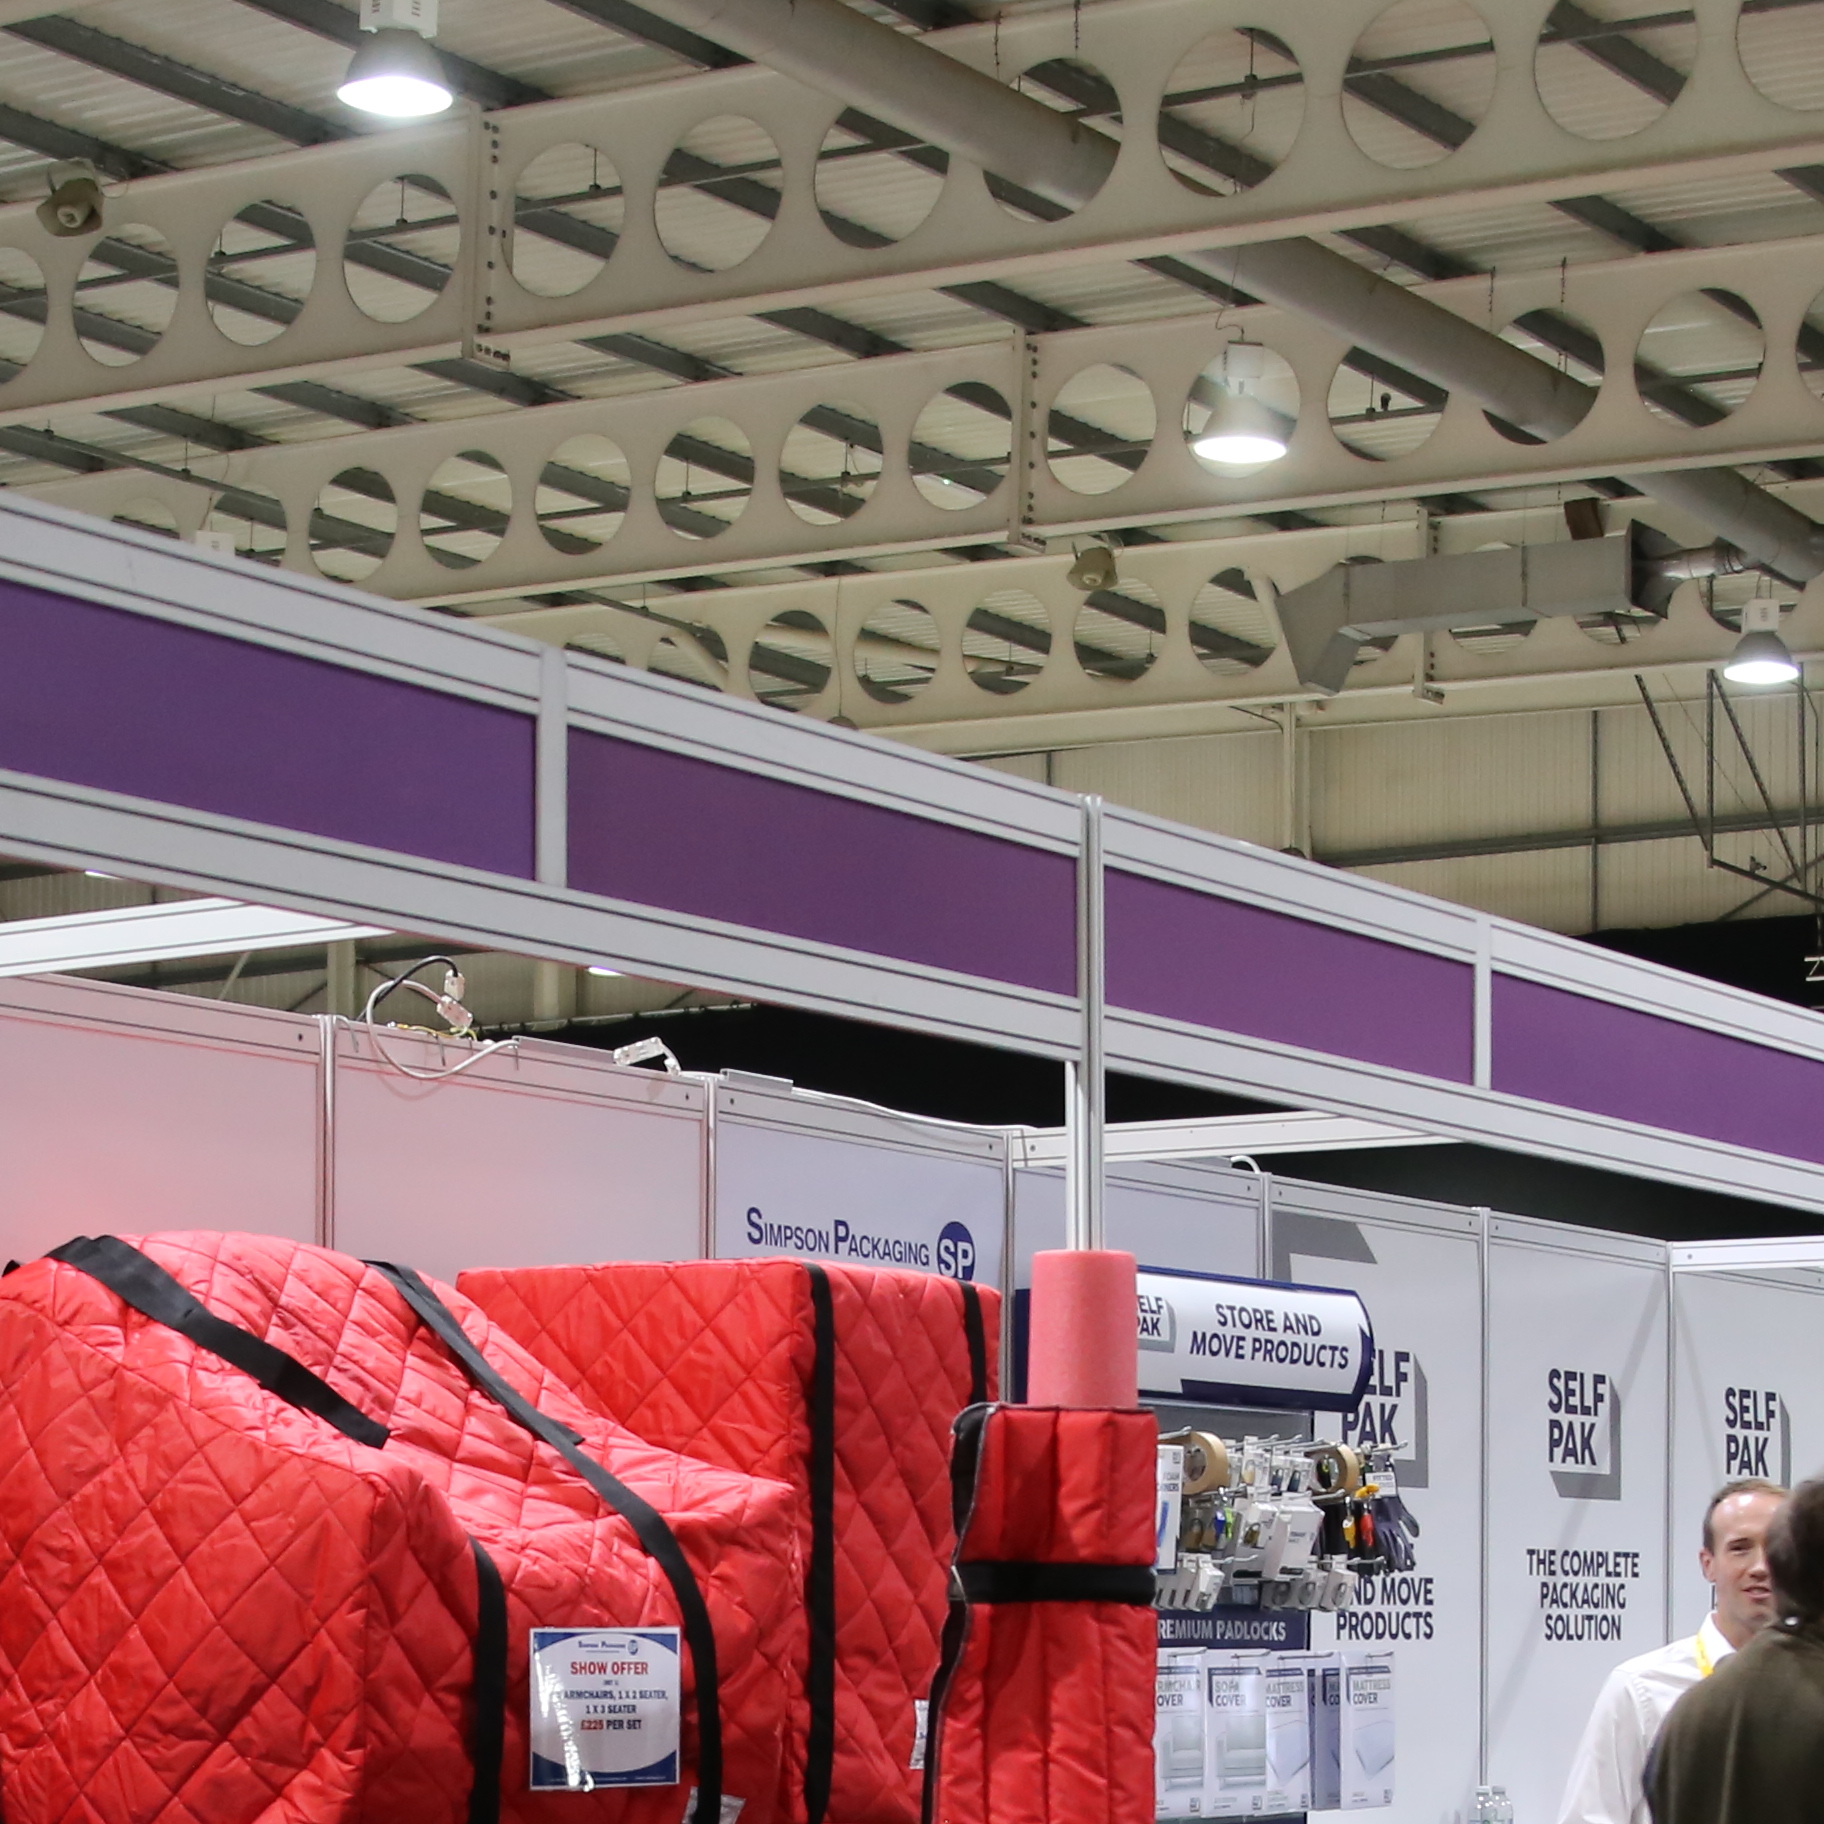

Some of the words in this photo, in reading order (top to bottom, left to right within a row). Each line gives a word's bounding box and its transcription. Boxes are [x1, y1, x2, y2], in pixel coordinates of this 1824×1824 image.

[745, 1206, 830, 1254] SIMPSON
[833, 1218, 931, 1267] PACKAGING
[938, 1237, 975, 1279] SP
[1137, 1294, 1164, 1315] ELF
[1214, 1302, 1278, 1333] STORE
[1282, 1310, 1323, 1337] AND
[1188, 1330, 1246, 1361] MOVE
[1250, 1337, 1350, 1371] PRODUCTS
[1363, 1348, 1410, 1397] LF
[1547, 1368, 1607, 1417] SELF
[1341, 1401, 1399, 1448] PAK
[1724, 1386, 1777, 1432] SELF
[1548, 1418, 1597, 1467] PAK
[1725, 1433, 1770, 1478] PAK
[1526, 1549, 1556, 1577] THE
[1560, 1549, 1640, 1579] COMPLETE
[1351, 1576, 1377, 1606] ND
[1380, 1576, 1435, 1607] MOVE
[1539, 1581, 1627, 1610] PACKAGING
[1157, 1617, 1213, 1641] REMIUM
[1215, 1619, 1287, 1642] PADLOCKS
[1335, 1610, 1434, 1641] PRODUCTS
[1544, 1613, 1622, 1642] SOLUTION
[570, 1661, 609, 1675] SHOW
[611, 1661, 649, 1675] OFFER
[1157, 1694, 1184, 1707] OVER
[1158, 1679, 1201, 1692] RMCHAIR
[606, 1719, 624, 1730] PER
[625, 1719, 643, 1730] SET
[607, 1704, 637, 1715] SEATER
